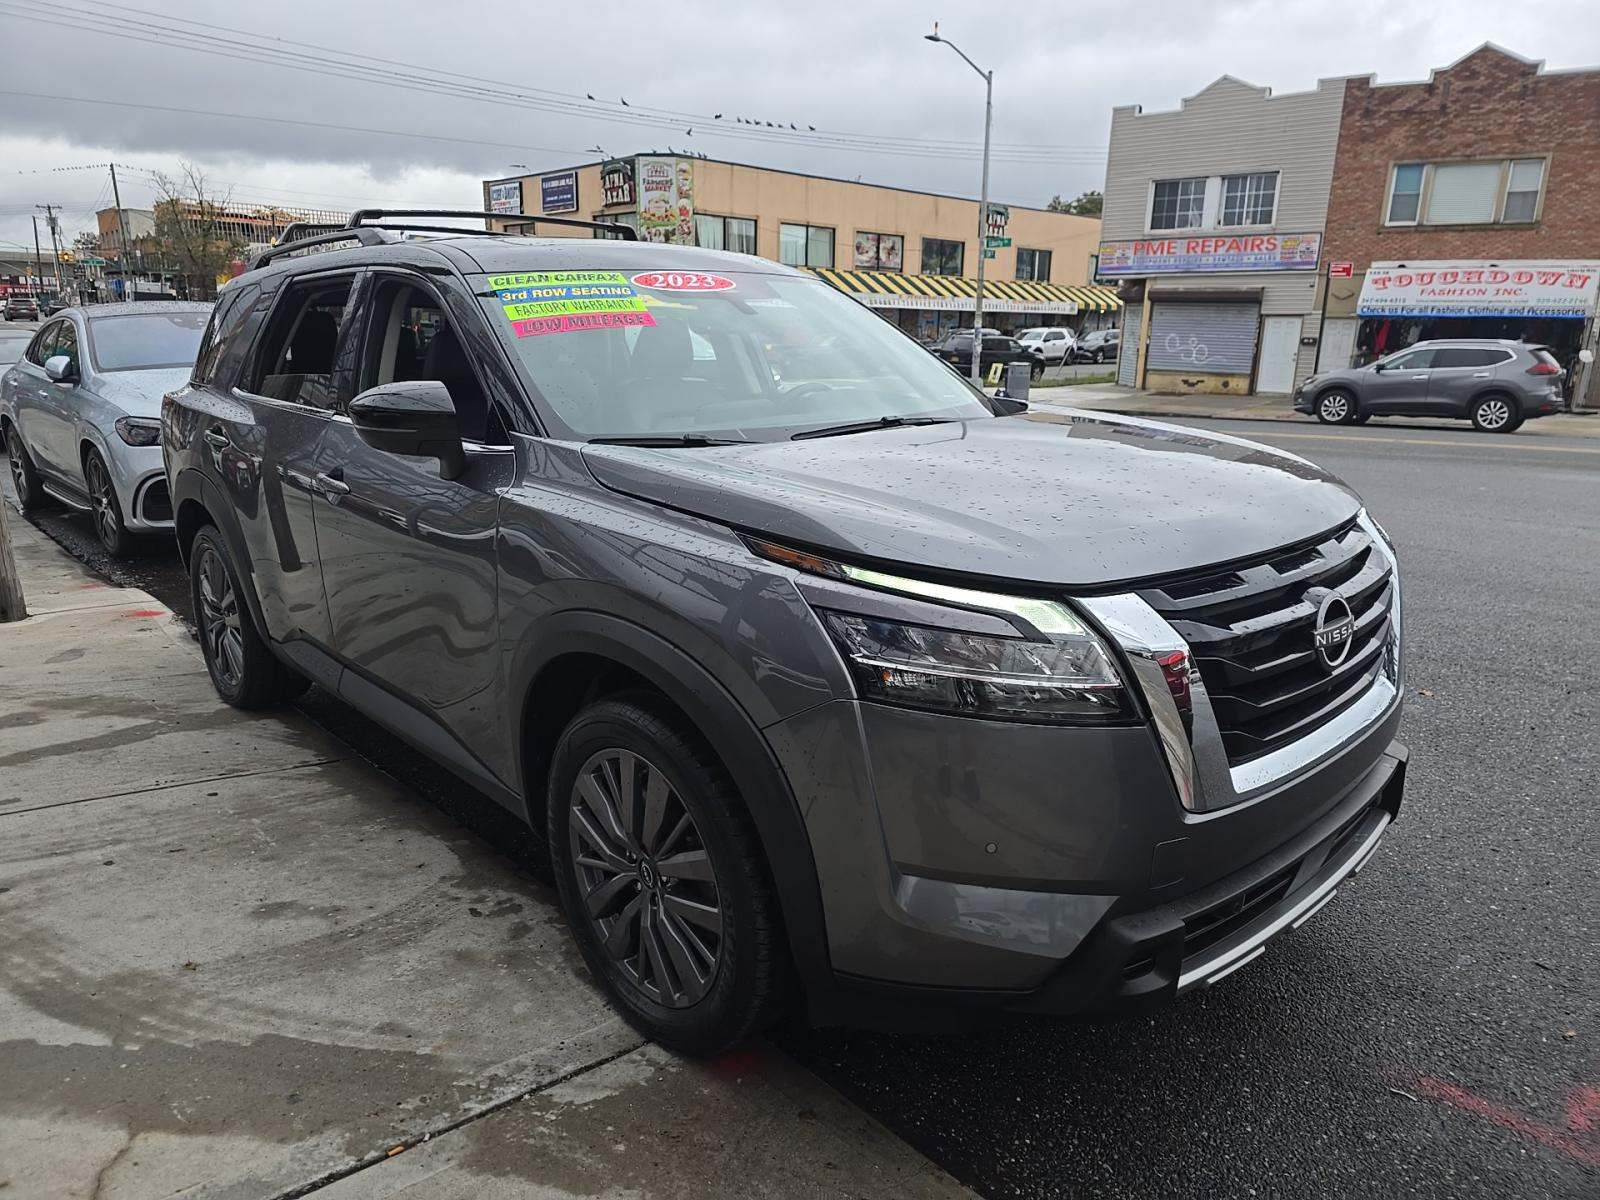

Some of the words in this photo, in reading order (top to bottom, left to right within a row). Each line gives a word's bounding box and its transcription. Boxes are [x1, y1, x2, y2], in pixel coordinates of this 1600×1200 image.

[604, 172, 624, 189] APNA
[601, 183, 631, 207] BAZAR
[1132, 240, 1178, 256] PME
[1186, 236, 1278, 254] REPAIRS
[493, 274, 550, 287] CLEAN
[554, 272, 620, 283] CARFAX
[651, 274, 716, 287] 2023
[1371, 270, 1591, 290] TOUCHDOWN
[502, 291, 528, 301] 3rd
[532, 287, 567, 298] ROW
[571, 286, 632, 297] SEATING
[1419, 288, 1488, 297] FASHION
[1492, 287, 1529, 297] INC.
[514, 301, 568, 316] FACTORY
[571, 298, 635, 312] WARRANTY
[1360, 305, 1386, 314] Check
[1388, 306, 1399, 314] us
[1401, 305, 1416, 315] For
[1417, 305, 1429, 314] all
[1430, 305, 1465, 315] Fashion
[1467, 306, 1505, 316] Clothing
[1508, 305, 1525, 315] and
[1527, 306, 1586, 316] Accessories
[522, 317, 563, 333] LOW
[567, 313, 646, 329] MILEAGE
